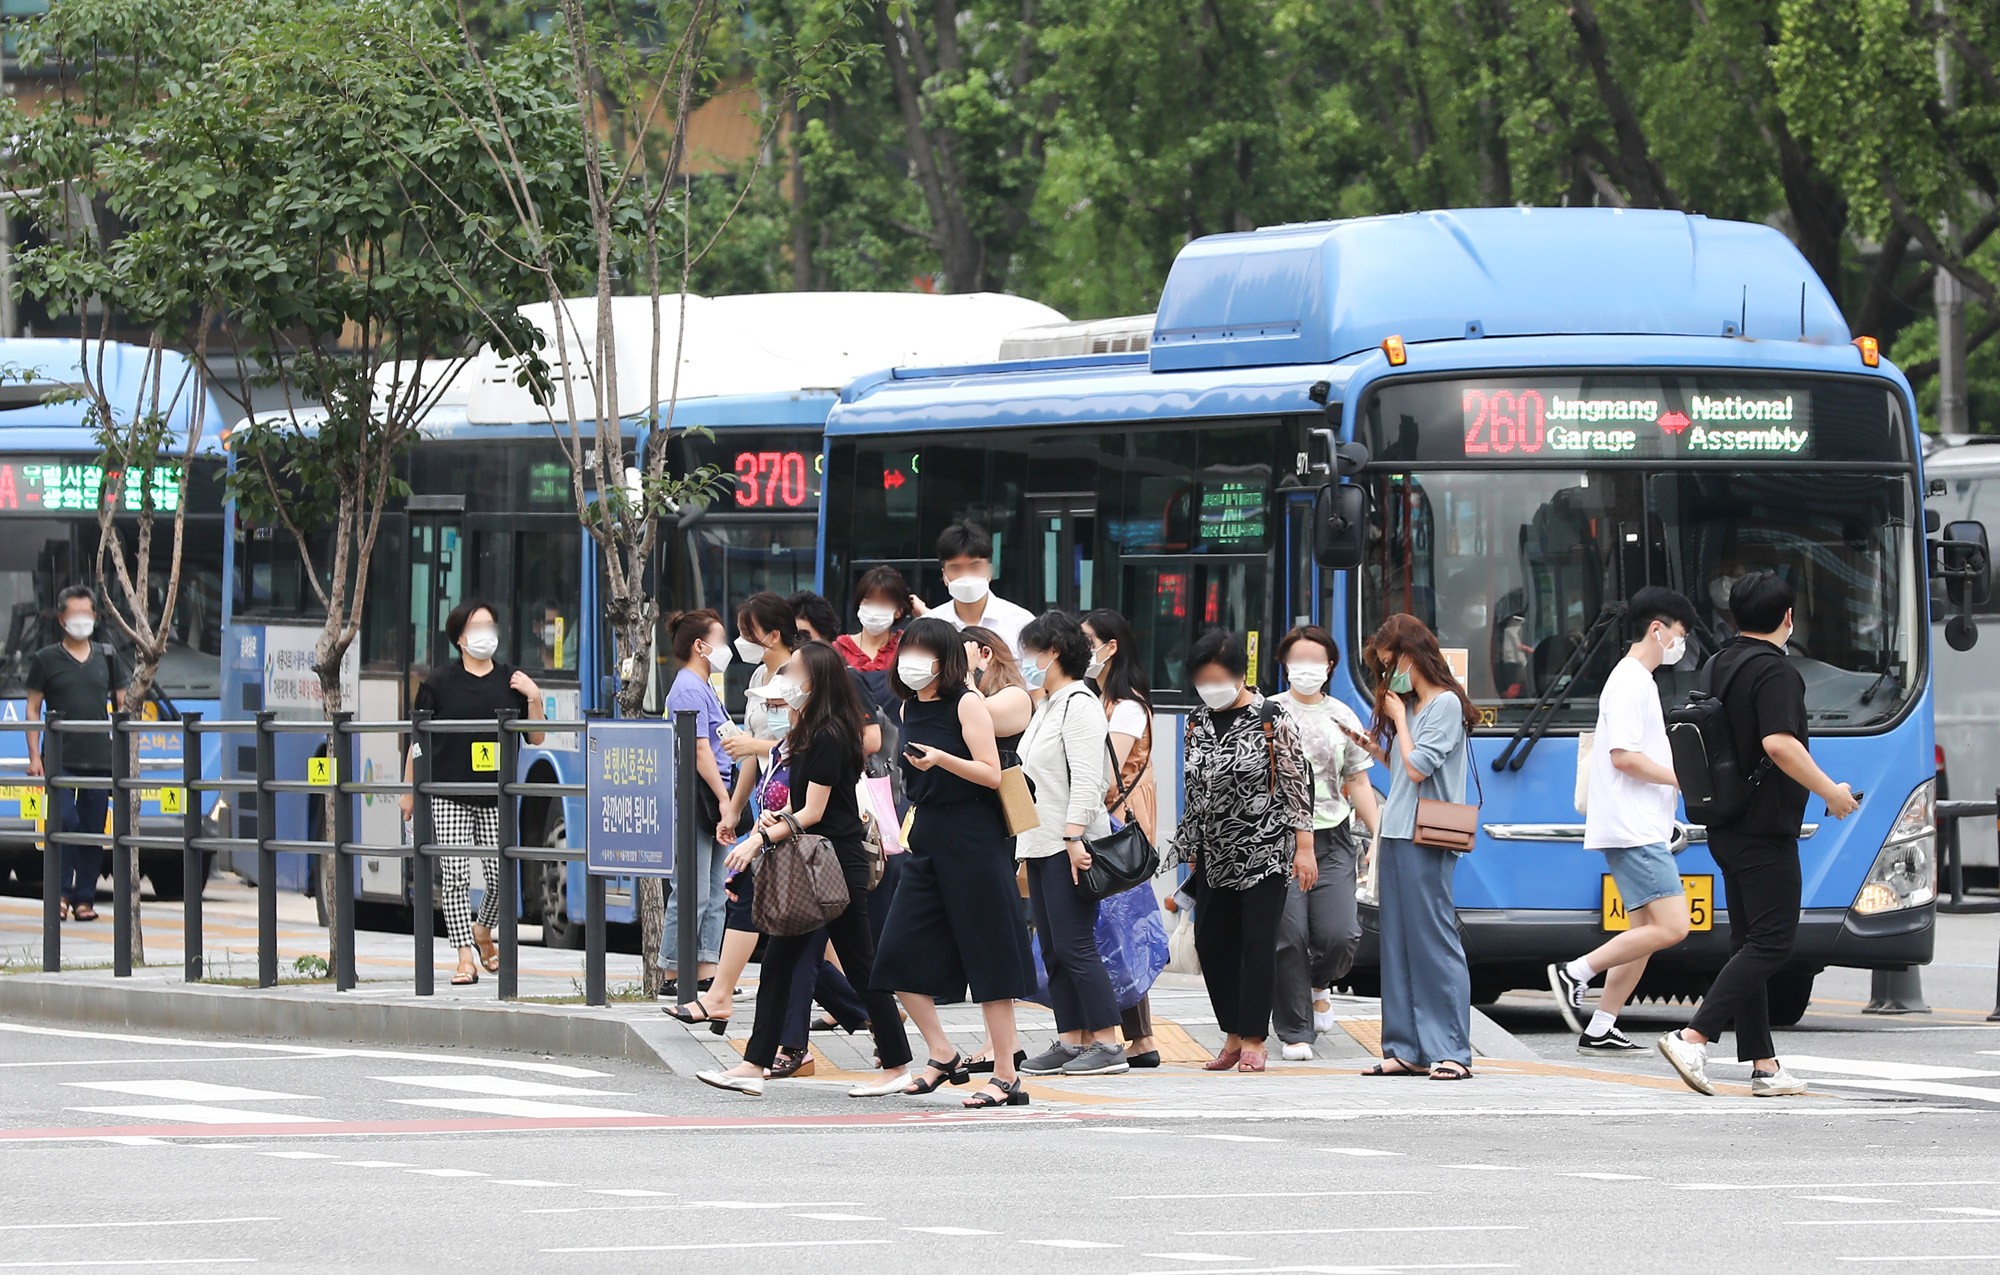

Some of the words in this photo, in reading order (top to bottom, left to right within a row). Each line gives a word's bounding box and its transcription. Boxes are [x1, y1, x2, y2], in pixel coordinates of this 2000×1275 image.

[1463, 390, 1545, 453] 260
[1545, 395, 1658, 421] Jungnang
[1691, 395, 1793, 421] National
[1547, 426, 1637, 452] Garage
[1688, 426, 1809, 452] Assembly
[735, 452, 806, 506] 370
[42, 487, 100, 510] 광화문
[603, 747, 657, 785] 보행신호준수!
[601, 795, 632, 833] 잠깐이면
[634, 796, 660, 834] 됩니다.
